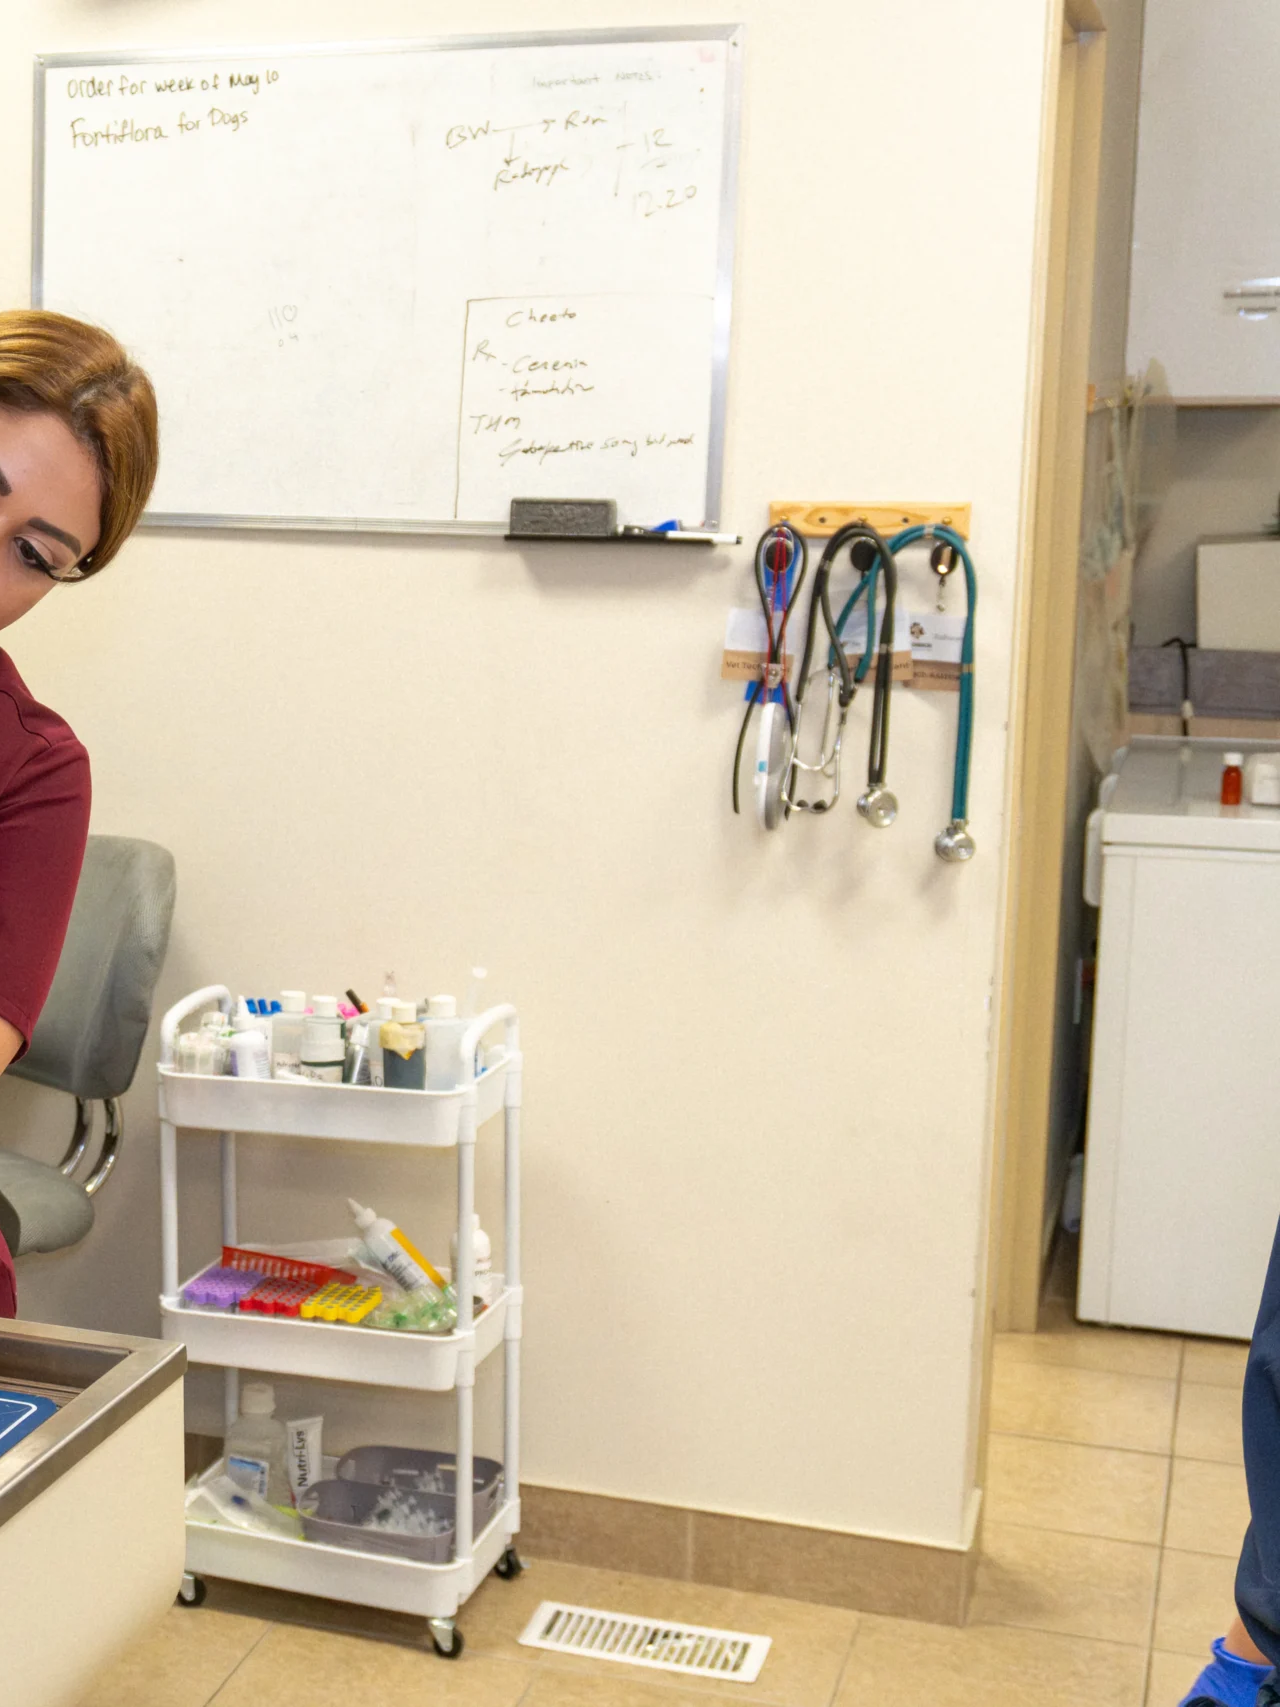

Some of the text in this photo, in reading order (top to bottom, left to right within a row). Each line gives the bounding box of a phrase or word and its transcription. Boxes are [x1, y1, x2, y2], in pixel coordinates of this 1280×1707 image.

[118, 74, 147, 95] for
[155, 77, 195, 92] week
[201, 73, 220, 91] of
[229, 72, 260, 95] May
[266, 69, 280, 85] 10
[70, 107, 249, 148] Fortiflora for Dogs
